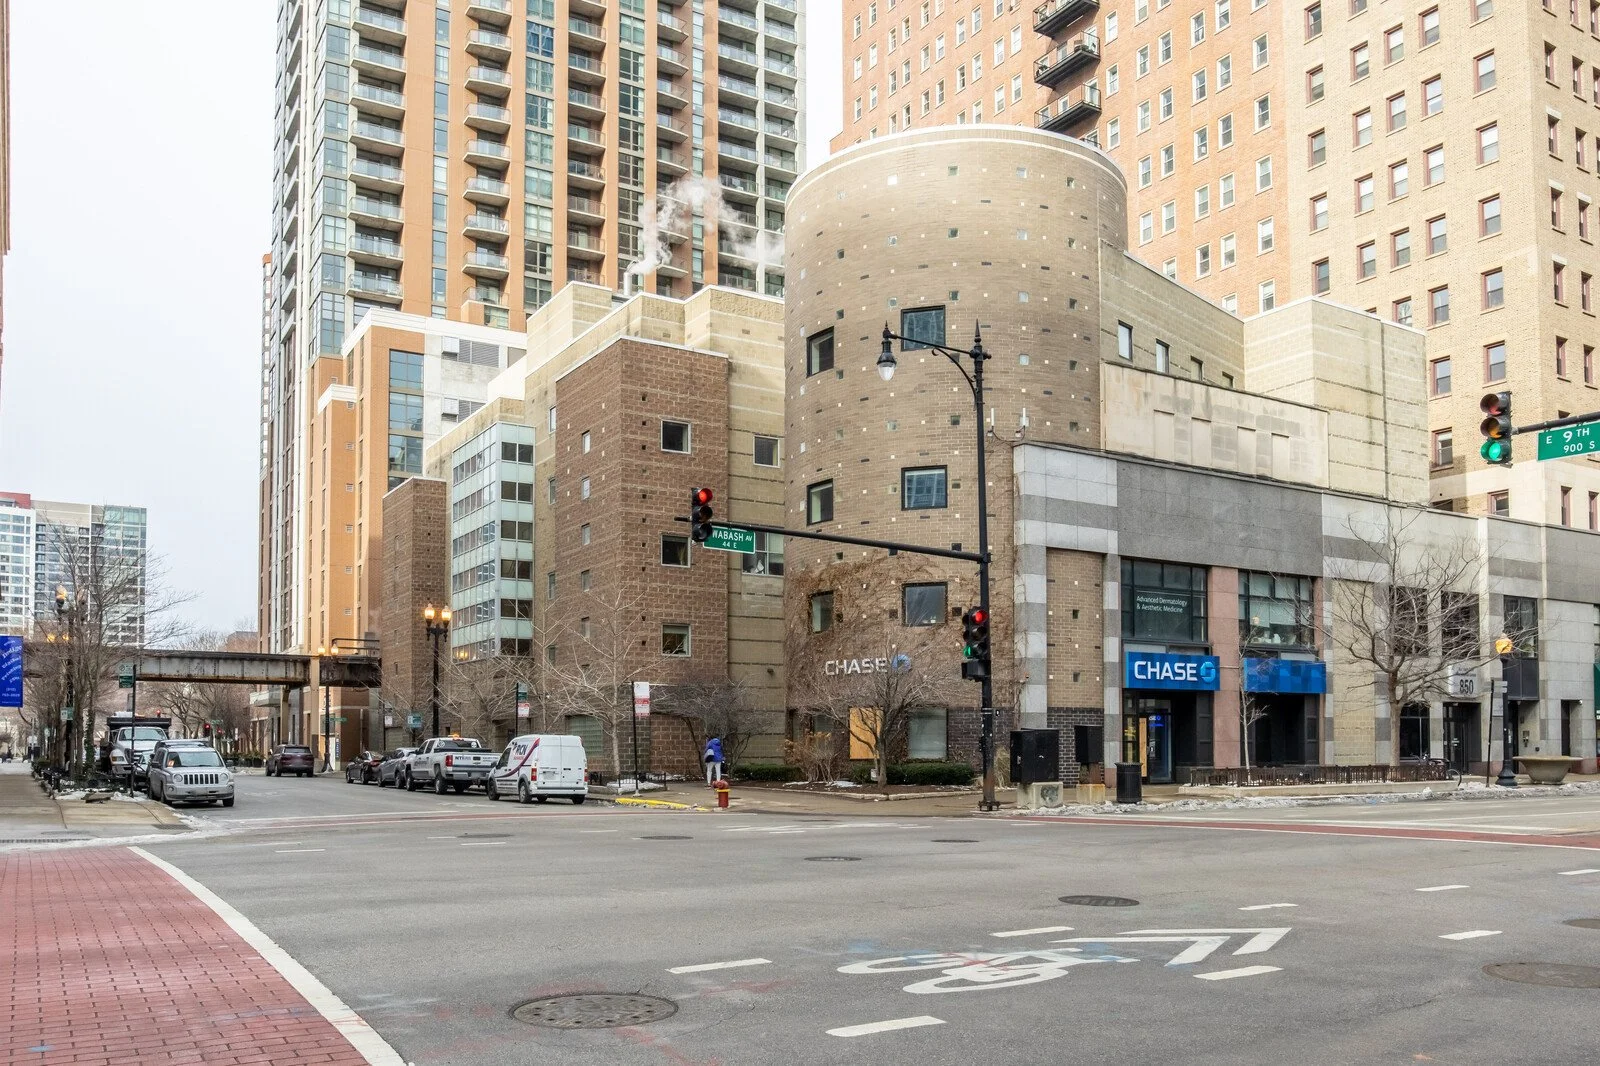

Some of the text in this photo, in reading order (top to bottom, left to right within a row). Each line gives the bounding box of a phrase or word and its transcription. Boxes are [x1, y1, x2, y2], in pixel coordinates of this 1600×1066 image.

[1546, 435, 1552, 444] E
[1563, 441, 1595, 453] 900 S
[712, 530, 744, 542] WABASH
[1136, 595, 1188, 607] Advanced Dermatology
[1141, 604, 1162, 612] Aesthetic
[1163, 605, 1183, 613] Medicine
[824, 657, 888, 676] CHASE
[1134, 660, 1198, 681] CHASE
[1460, 679, 1474, 695] 850
